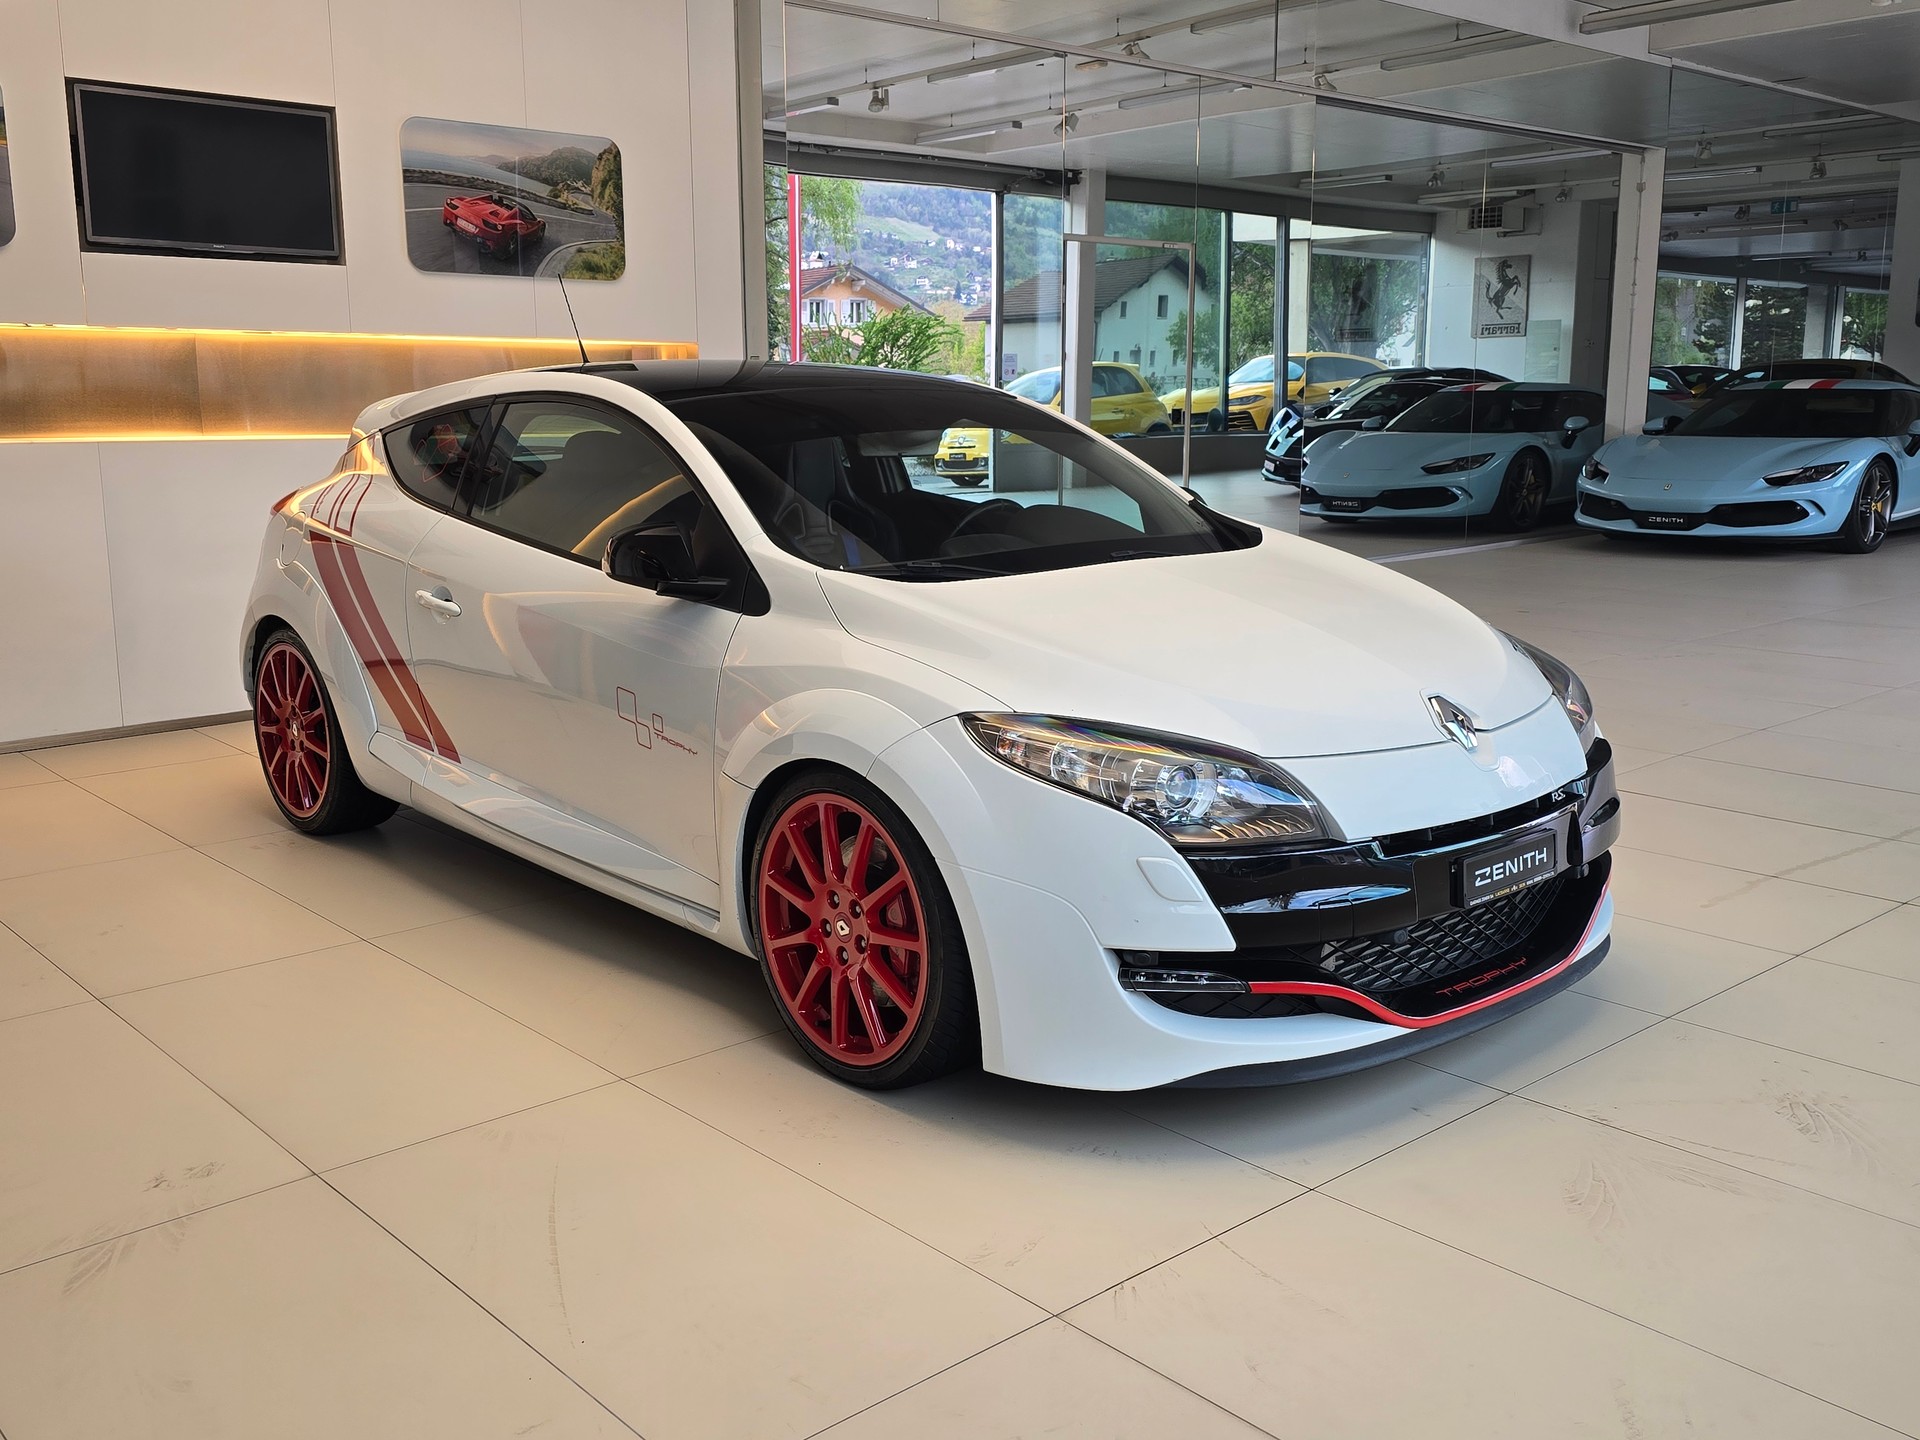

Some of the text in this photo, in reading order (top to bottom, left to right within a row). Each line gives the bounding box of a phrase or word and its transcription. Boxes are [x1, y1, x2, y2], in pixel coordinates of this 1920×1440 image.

[1551, 787, 1566, 803] RS
[1474, 847, 1548, 887] ZENITH
[1435, 956, 1527, 997] TROPHY
